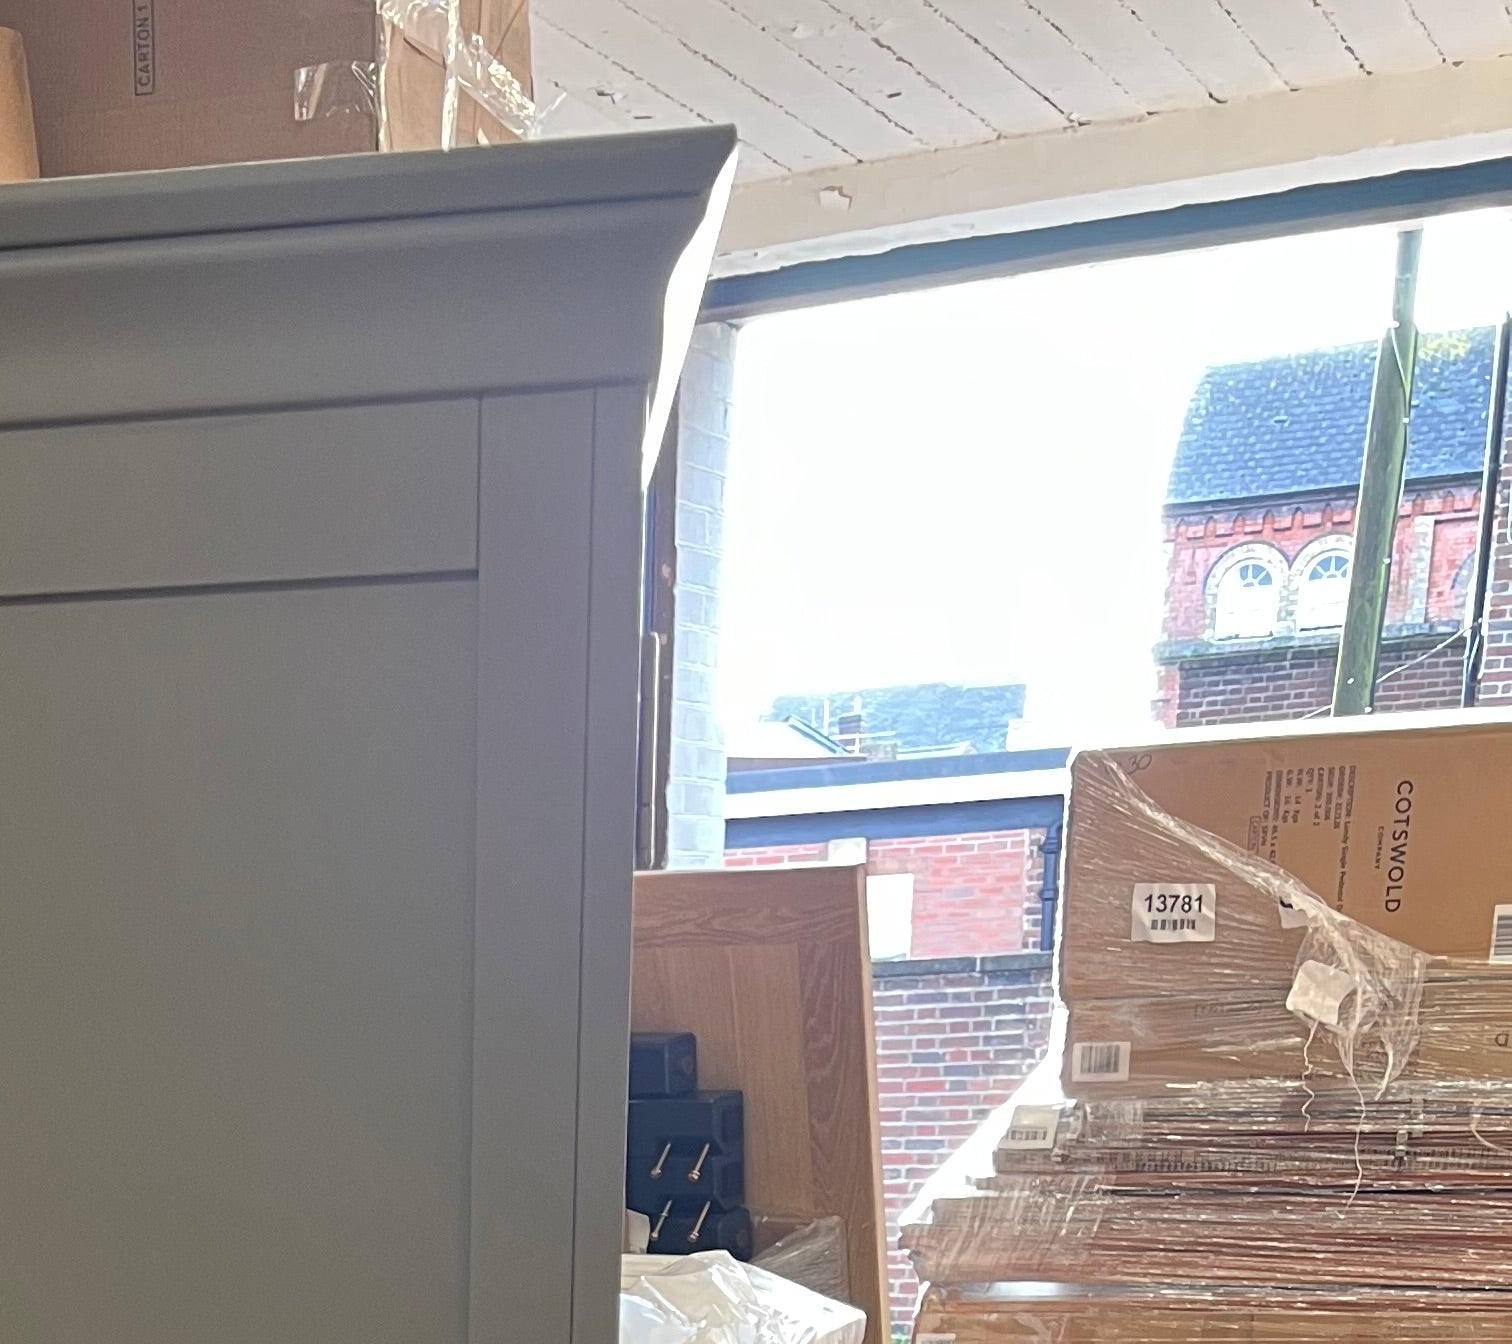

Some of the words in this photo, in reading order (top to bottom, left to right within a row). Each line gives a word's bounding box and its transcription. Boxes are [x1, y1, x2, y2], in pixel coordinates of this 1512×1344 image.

[136, 16, 151, 87] CARTON
[1374, 825, 1385, 870] COMPANY
[1384, 780, 1414, 913] COTSWOLD
[1144, 894, 1203, 913] 13781
